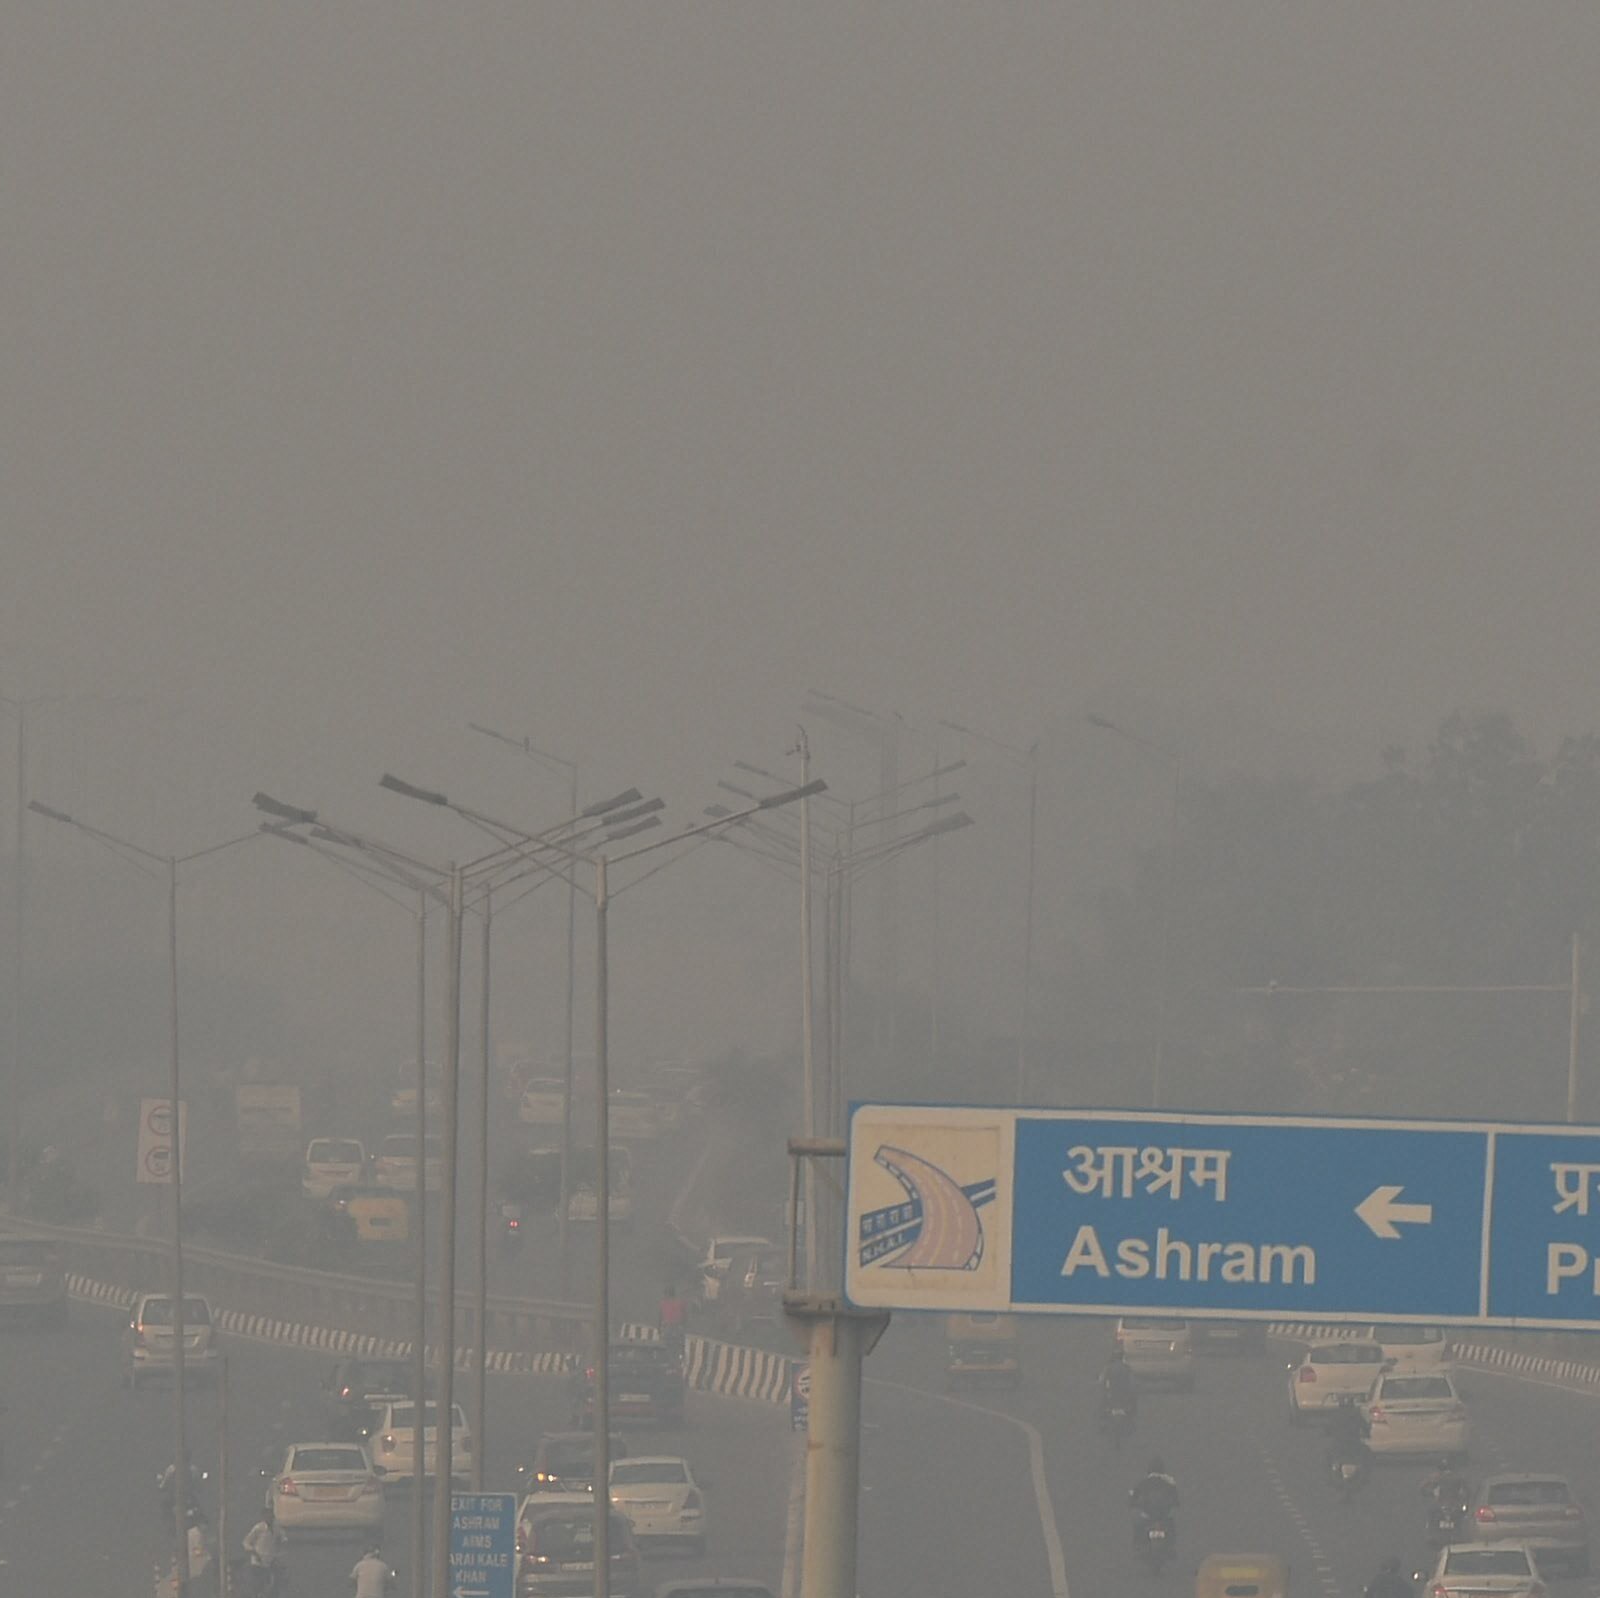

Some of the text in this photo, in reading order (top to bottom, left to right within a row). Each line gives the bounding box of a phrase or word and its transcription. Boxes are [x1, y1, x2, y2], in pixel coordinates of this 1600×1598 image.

[1062, 1145, 1232, 1202] आश्रम
[1060, 1225, 1316, 1285] Ashram
[450, 1497, 504, 1512] EXIT FOR
[453, 1515, 500, 1529] ASHRAM
[477, 1554, 509, 1568] KALE
[455, 1569, 488, 1584] KHAN
